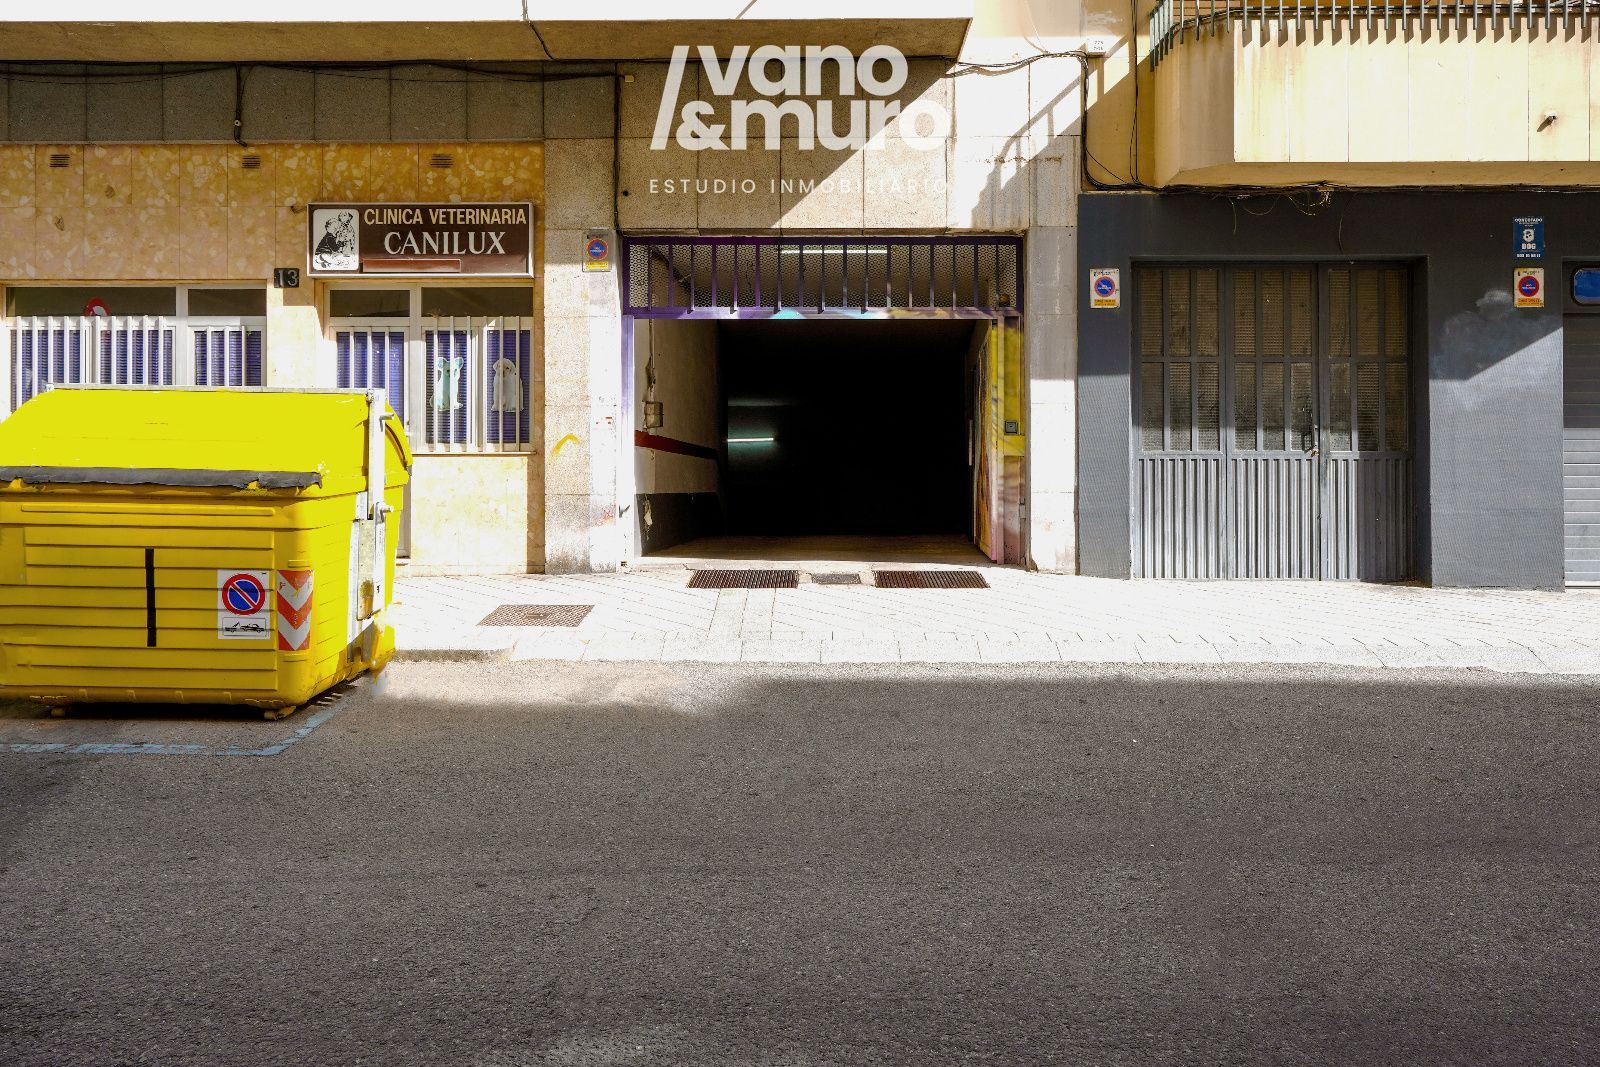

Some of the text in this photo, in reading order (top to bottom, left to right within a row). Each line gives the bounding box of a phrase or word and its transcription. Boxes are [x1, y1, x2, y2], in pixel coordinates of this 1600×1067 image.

[364, 208, 527, 225] CLINICA VETERINARIA
[383, 230, 506, 256] CANILUX
[278, 269, 298, 288] 13
